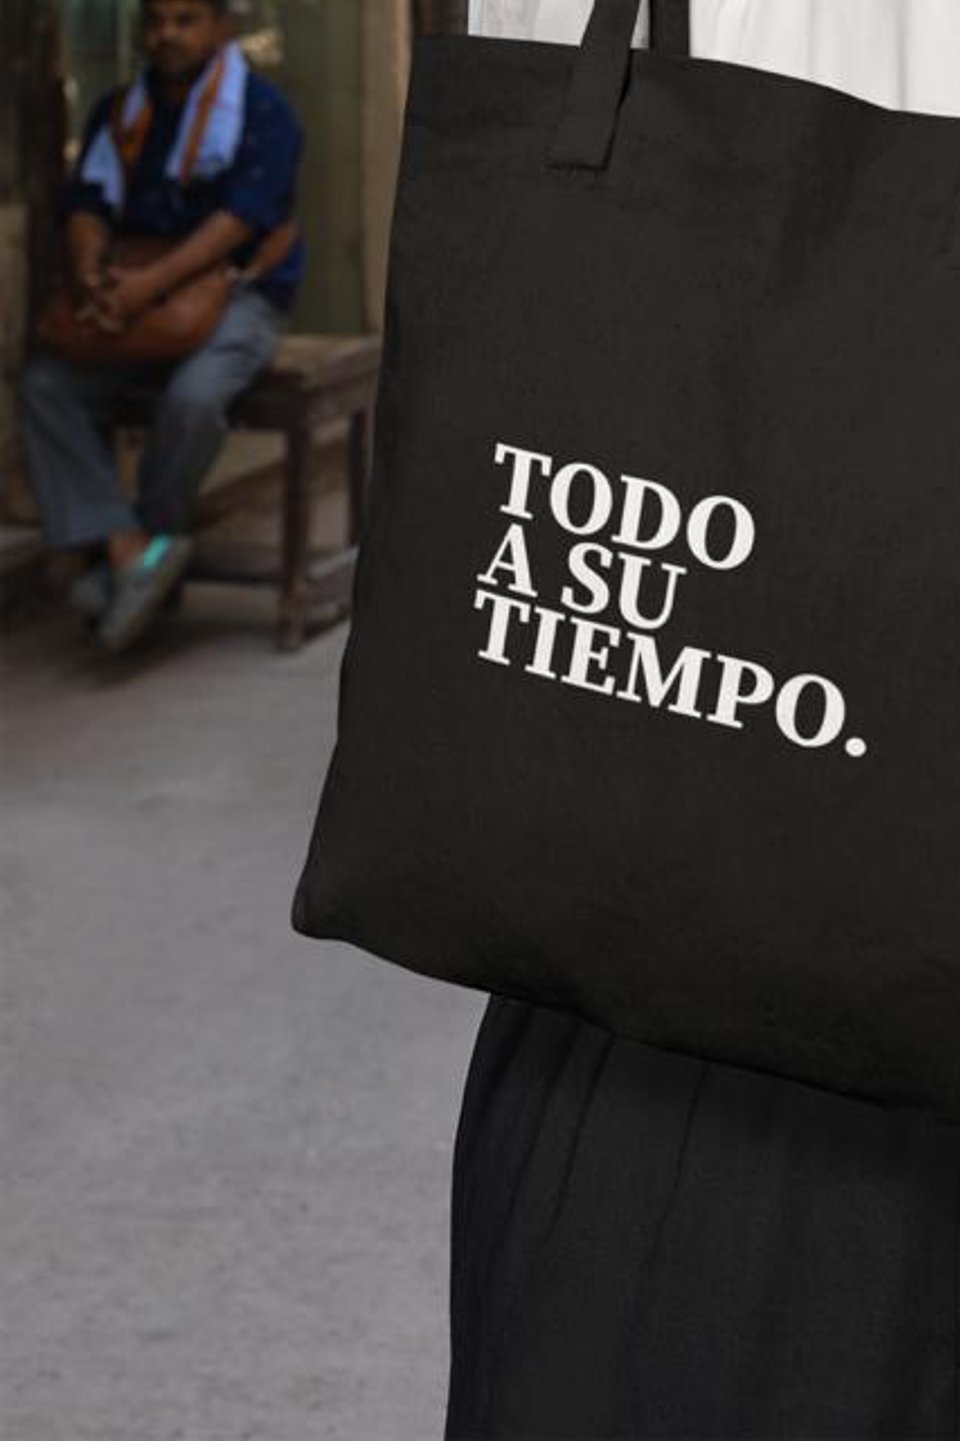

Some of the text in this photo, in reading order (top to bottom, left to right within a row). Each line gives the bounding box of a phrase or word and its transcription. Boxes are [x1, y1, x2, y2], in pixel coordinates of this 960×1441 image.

[494, 442, 755, 570] TODO
[476, 523, 687, 630] A SU
[474, 589, 867, 757] TIEMPO.
